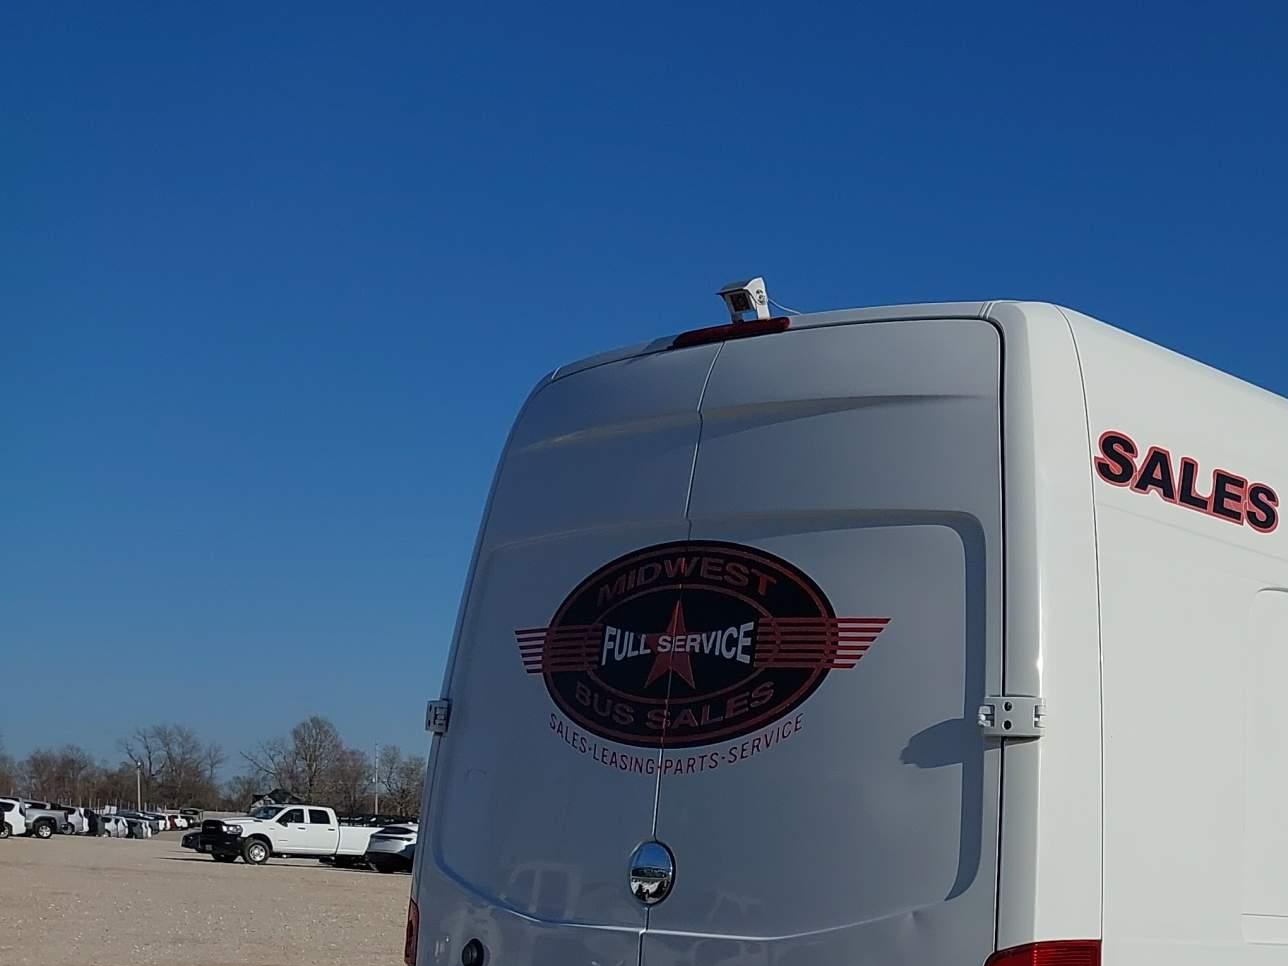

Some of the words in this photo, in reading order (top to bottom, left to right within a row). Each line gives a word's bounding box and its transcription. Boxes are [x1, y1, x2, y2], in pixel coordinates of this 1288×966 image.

[1093, 429, 1279, 534] SALES
[597, 556, 777, 606] MIDWEST
[601, 625, 651, 666] FULL
[657, 621, 755, 664] SERVICE
[574, 680, 635, 727] BUS
[645, 681, 776, 731] SALES
